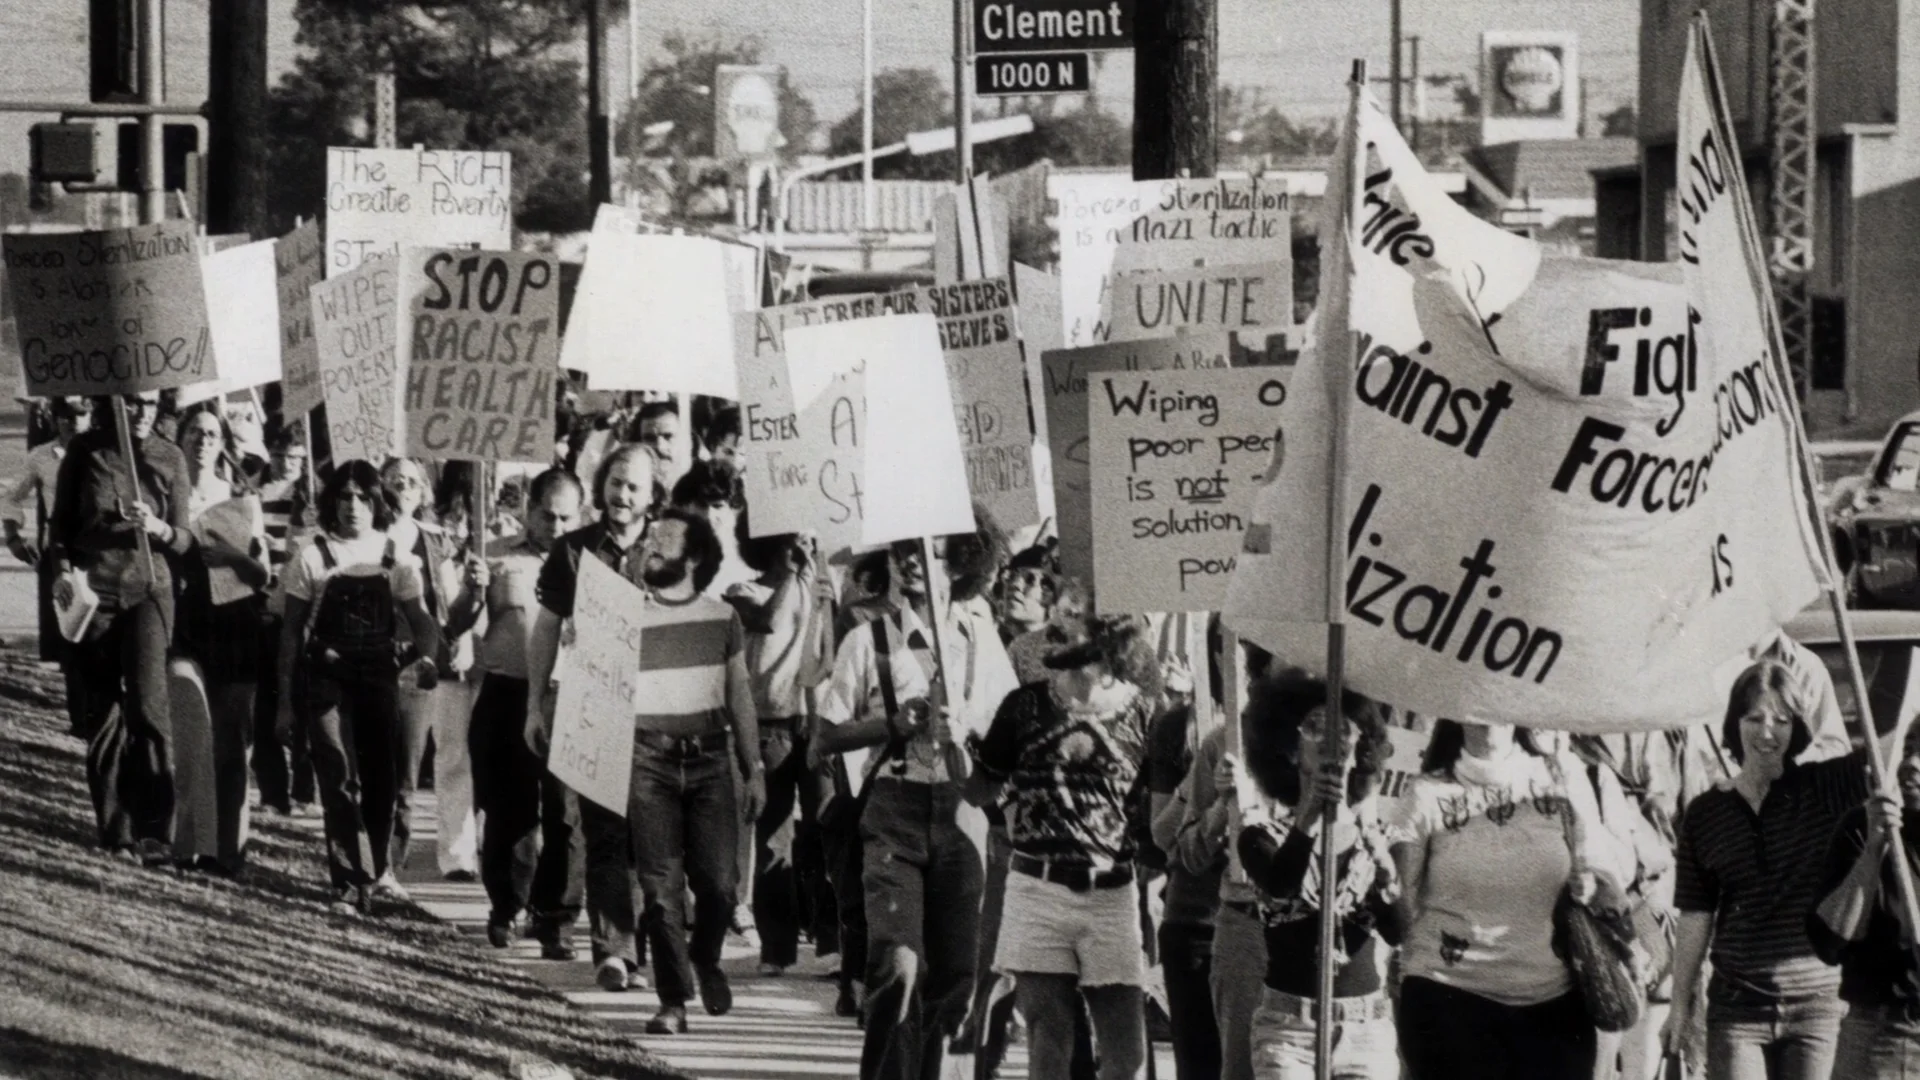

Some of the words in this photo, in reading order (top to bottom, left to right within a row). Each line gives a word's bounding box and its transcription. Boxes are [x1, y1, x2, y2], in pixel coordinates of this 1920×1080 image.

[982, 2, 1123, 41] Clement
[991, 62, 1050, 89] 1000
[1059, 62, 1074, 86] N
[338, 149, 387, 183] The
[328, 181, 411, 214] Create
[432, 181, 509, 231] Poverty
[1160, 179, 1289, 212] Sterilization
[1209, 210, 1279, 240] tactic
[319, 269, 396, 322] WIPE
[423, 251, 551, 316] STOP
[927, 279, 1010, 318] SISTERS
[1136, 276, 1264, 329] UNITE
[341, 312, 388, 360] OUT
[411, 314, 550, 365] RACIST
[405, 365, 550, 420] HEALTH
[1103, 377, 1219, 427] Wiping
[421, 412, 541, 460] CARE
[1128, 436, 1205, 473] poor
[1126, 476, 1154, 502] is
[1174, 469, 1230, 500] not
[1131, 508, 1244, 539] solution
